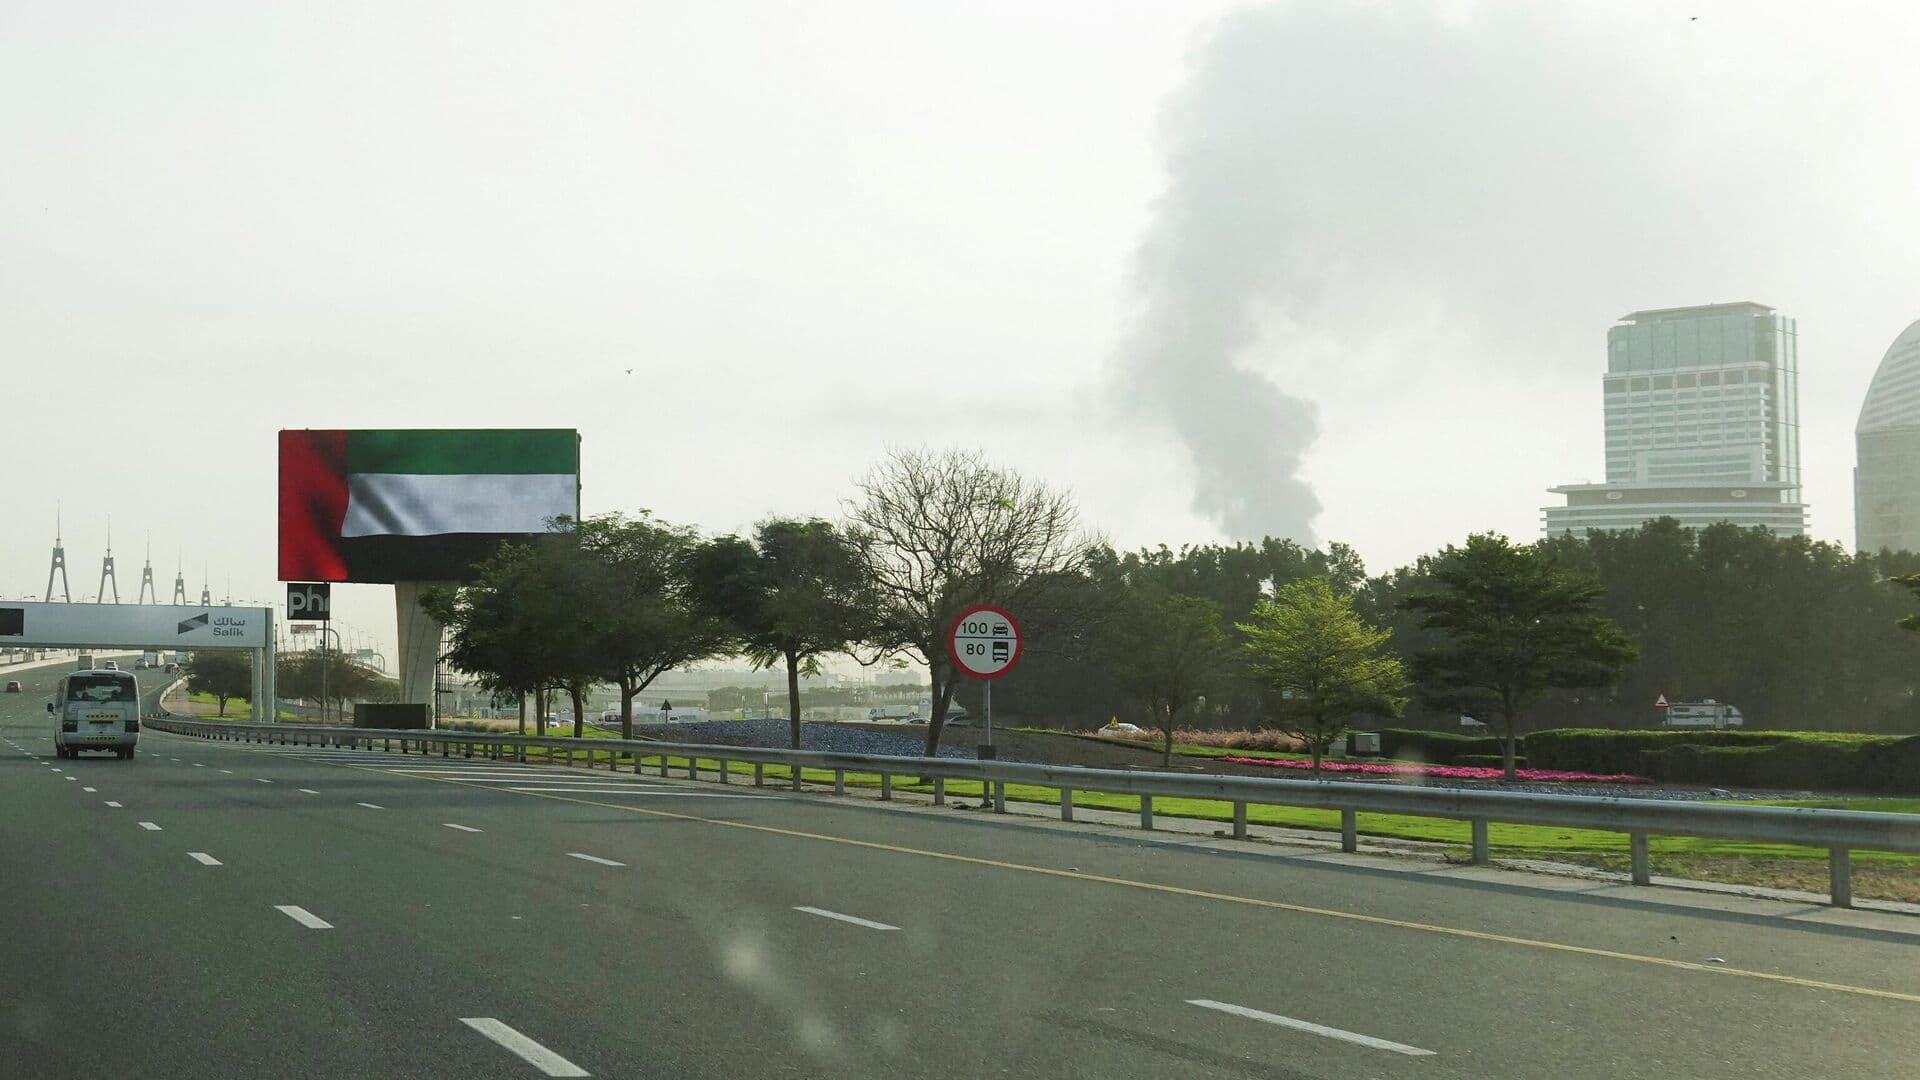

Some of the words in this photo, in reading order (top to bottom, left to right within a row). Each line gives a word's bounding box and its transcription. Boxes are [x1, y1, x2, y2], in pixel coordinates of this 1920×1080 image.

[213, 617, 245, 626] سالك
[213, 627, 244, 637] Salik
[962, 622, 988, 634] 100
[966, 644, 985, 655] 80
